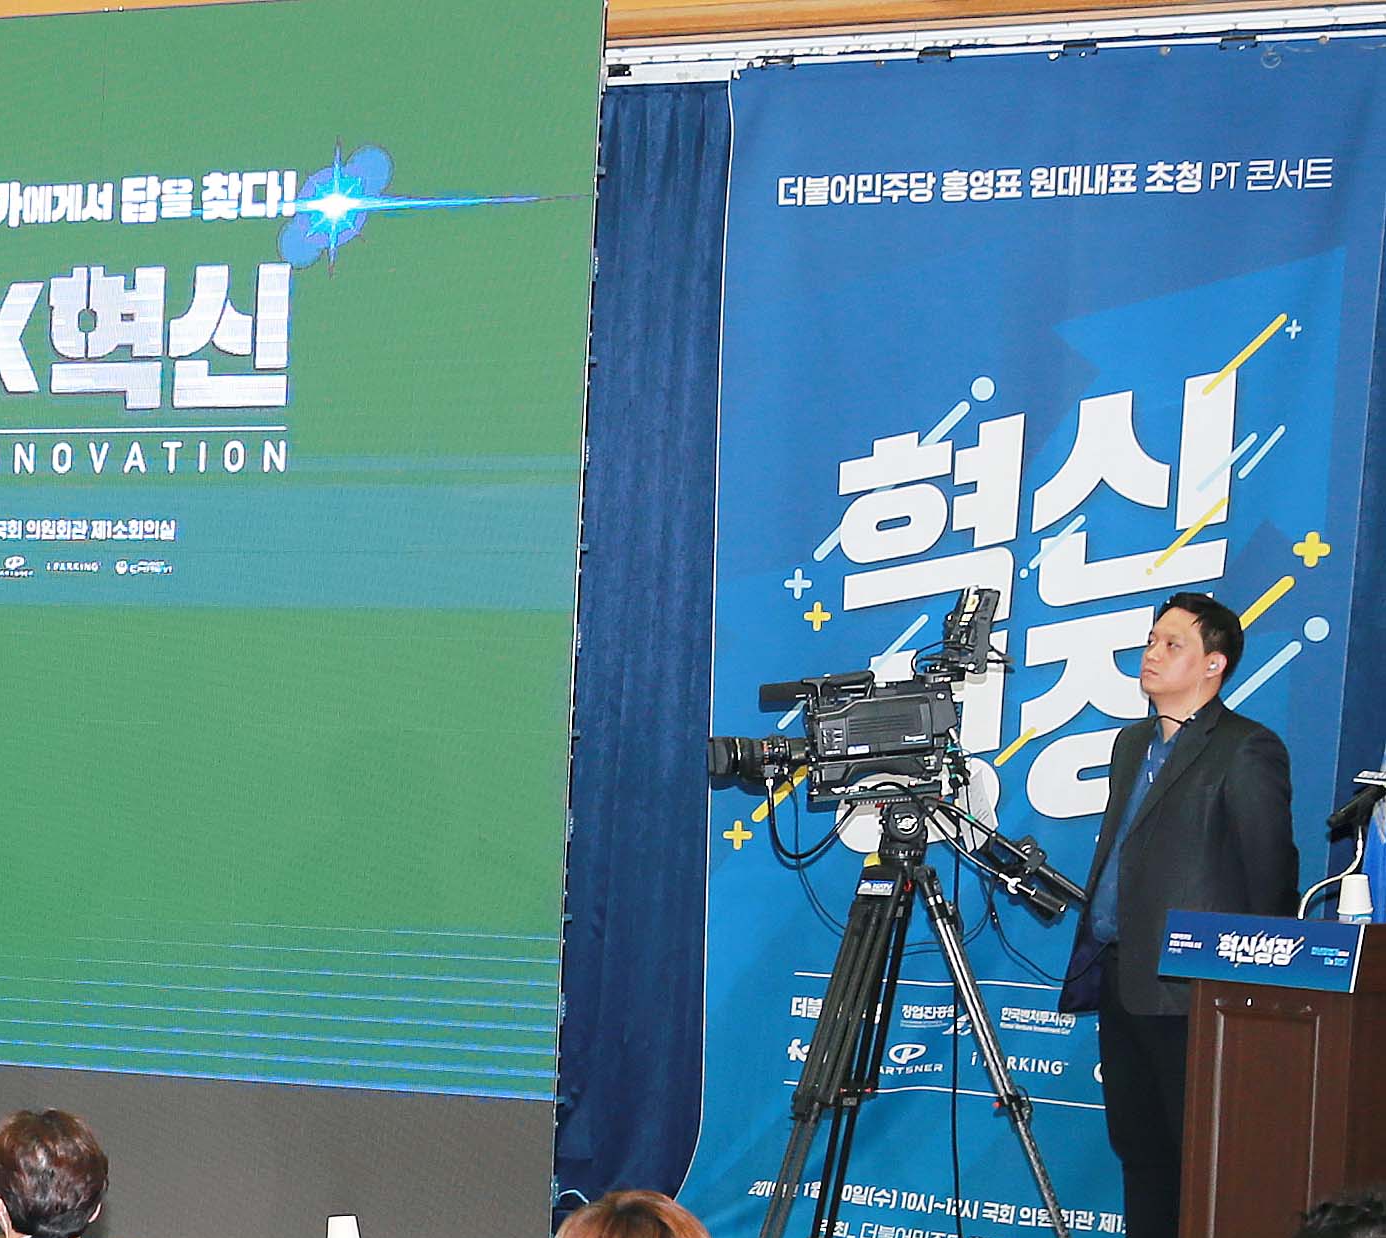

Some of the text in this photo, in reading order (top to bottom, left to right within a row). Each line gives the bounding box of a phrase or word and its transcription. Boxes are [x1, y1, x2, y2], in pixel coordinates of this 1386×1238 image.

[119, 174, 194, 224] 답을
[201, 169, 298, 222] 찾다!
[777, 157, 1334, 207] 더불어민주당 홍영표 원대내표 초청 PT 콘서트
[837, 366, 1238, 622] 혁신
[25, 518, 89, 541] 의원회관
[90, 518, 177, 541] 제1소회의실
[1217, 932, 1296, 967] 혁신성장
[840, 1183, 898, 1209] 0일(수)
[982, 1201, 1016, 1225] 국회
